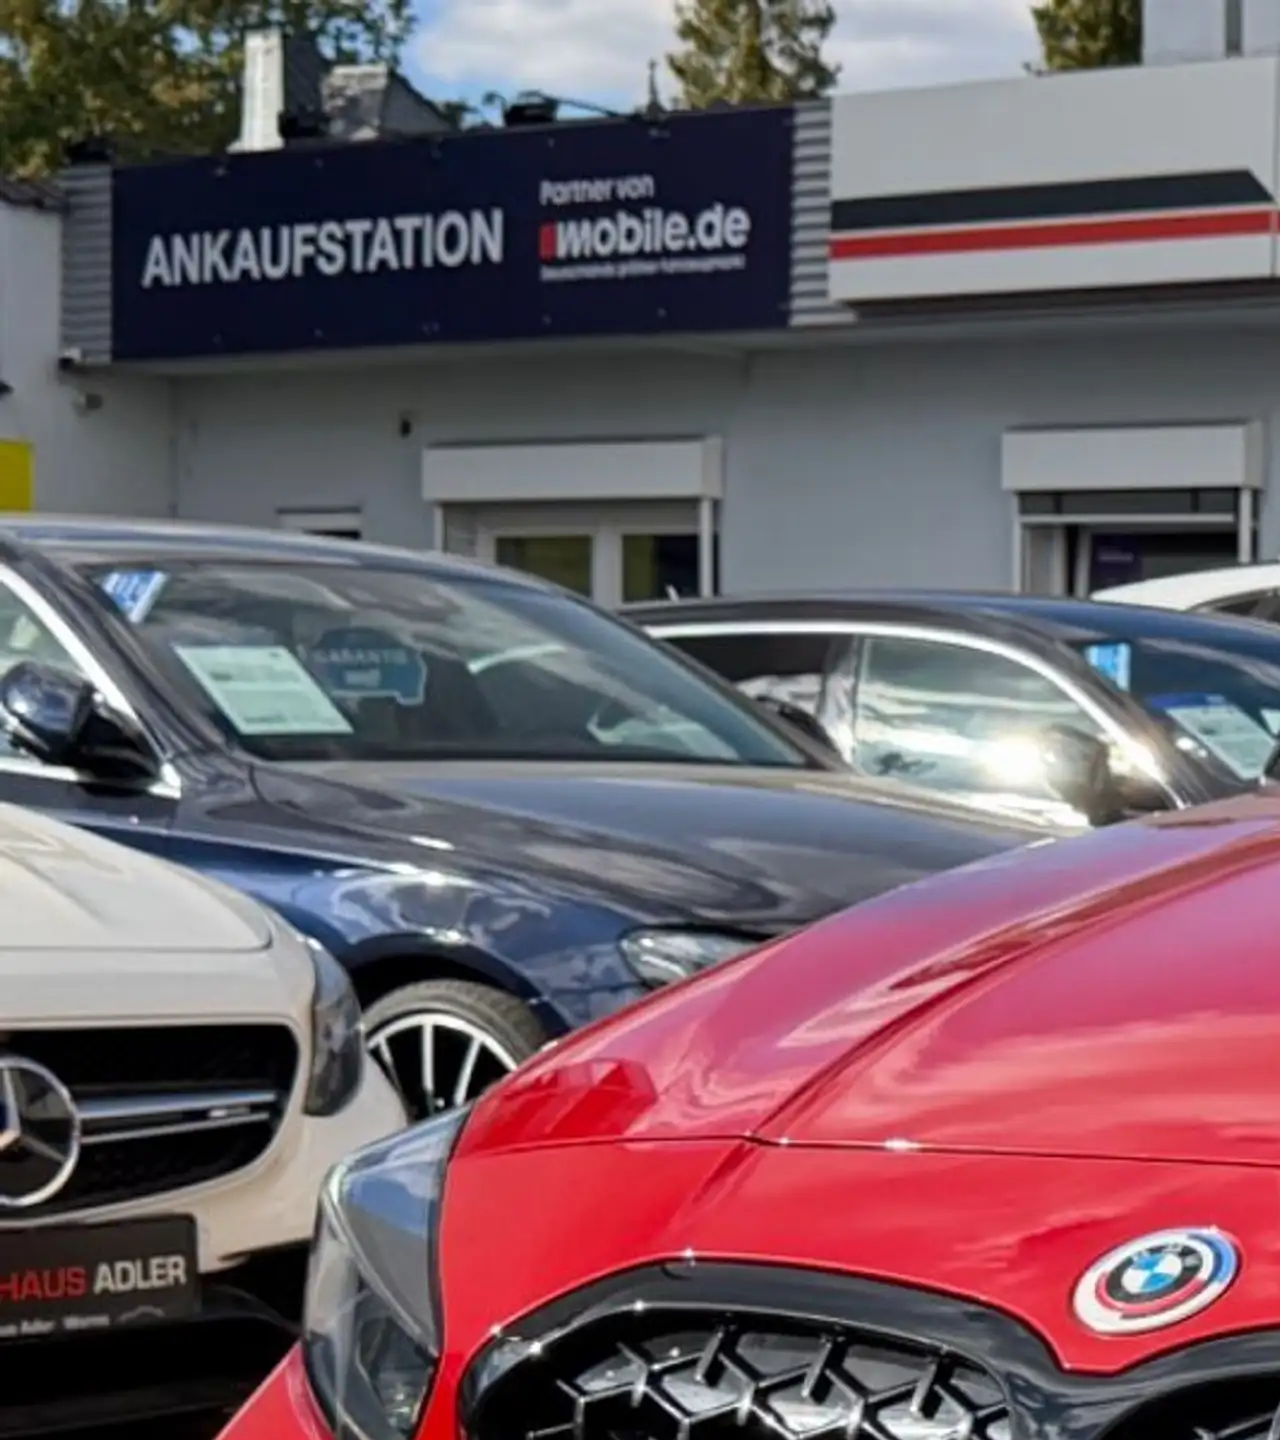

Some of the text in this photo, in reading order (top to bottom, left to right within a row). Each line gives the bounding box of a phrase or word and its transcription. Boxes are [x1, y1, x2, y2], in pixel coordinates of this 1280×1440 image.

[539, 174, 655, 206] Partner von
[140, 206, 503, 290] ANKAUFSTATION
[555, 202, 751, 259] mobile.de
[92, 1253, 188, 1296] ADLER
